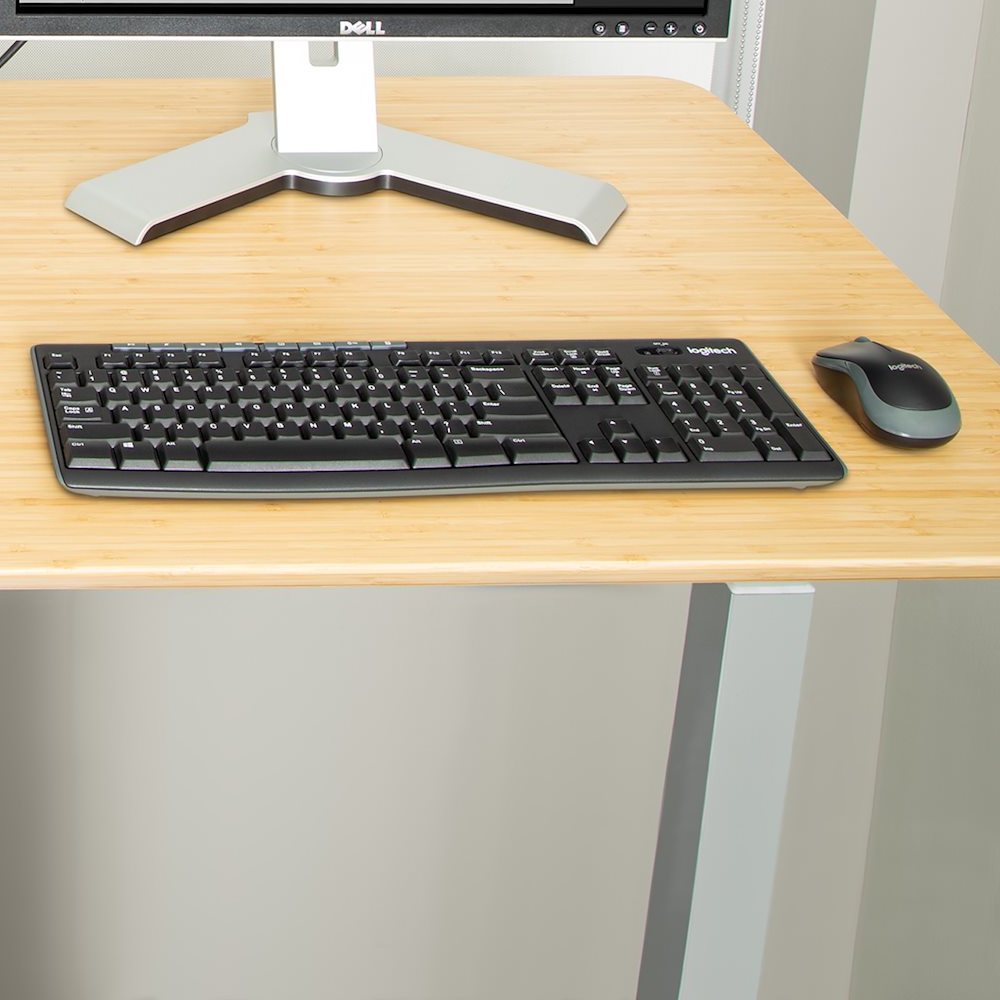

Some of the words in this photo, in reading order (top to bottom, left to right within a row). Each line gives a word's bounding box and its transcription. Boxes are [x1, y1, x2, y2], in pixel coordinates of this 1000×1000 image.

[340, 20, 386, 36] DELL
[687, 347, 737, 356] logitech
[888, 362, 923, 372] logitech
